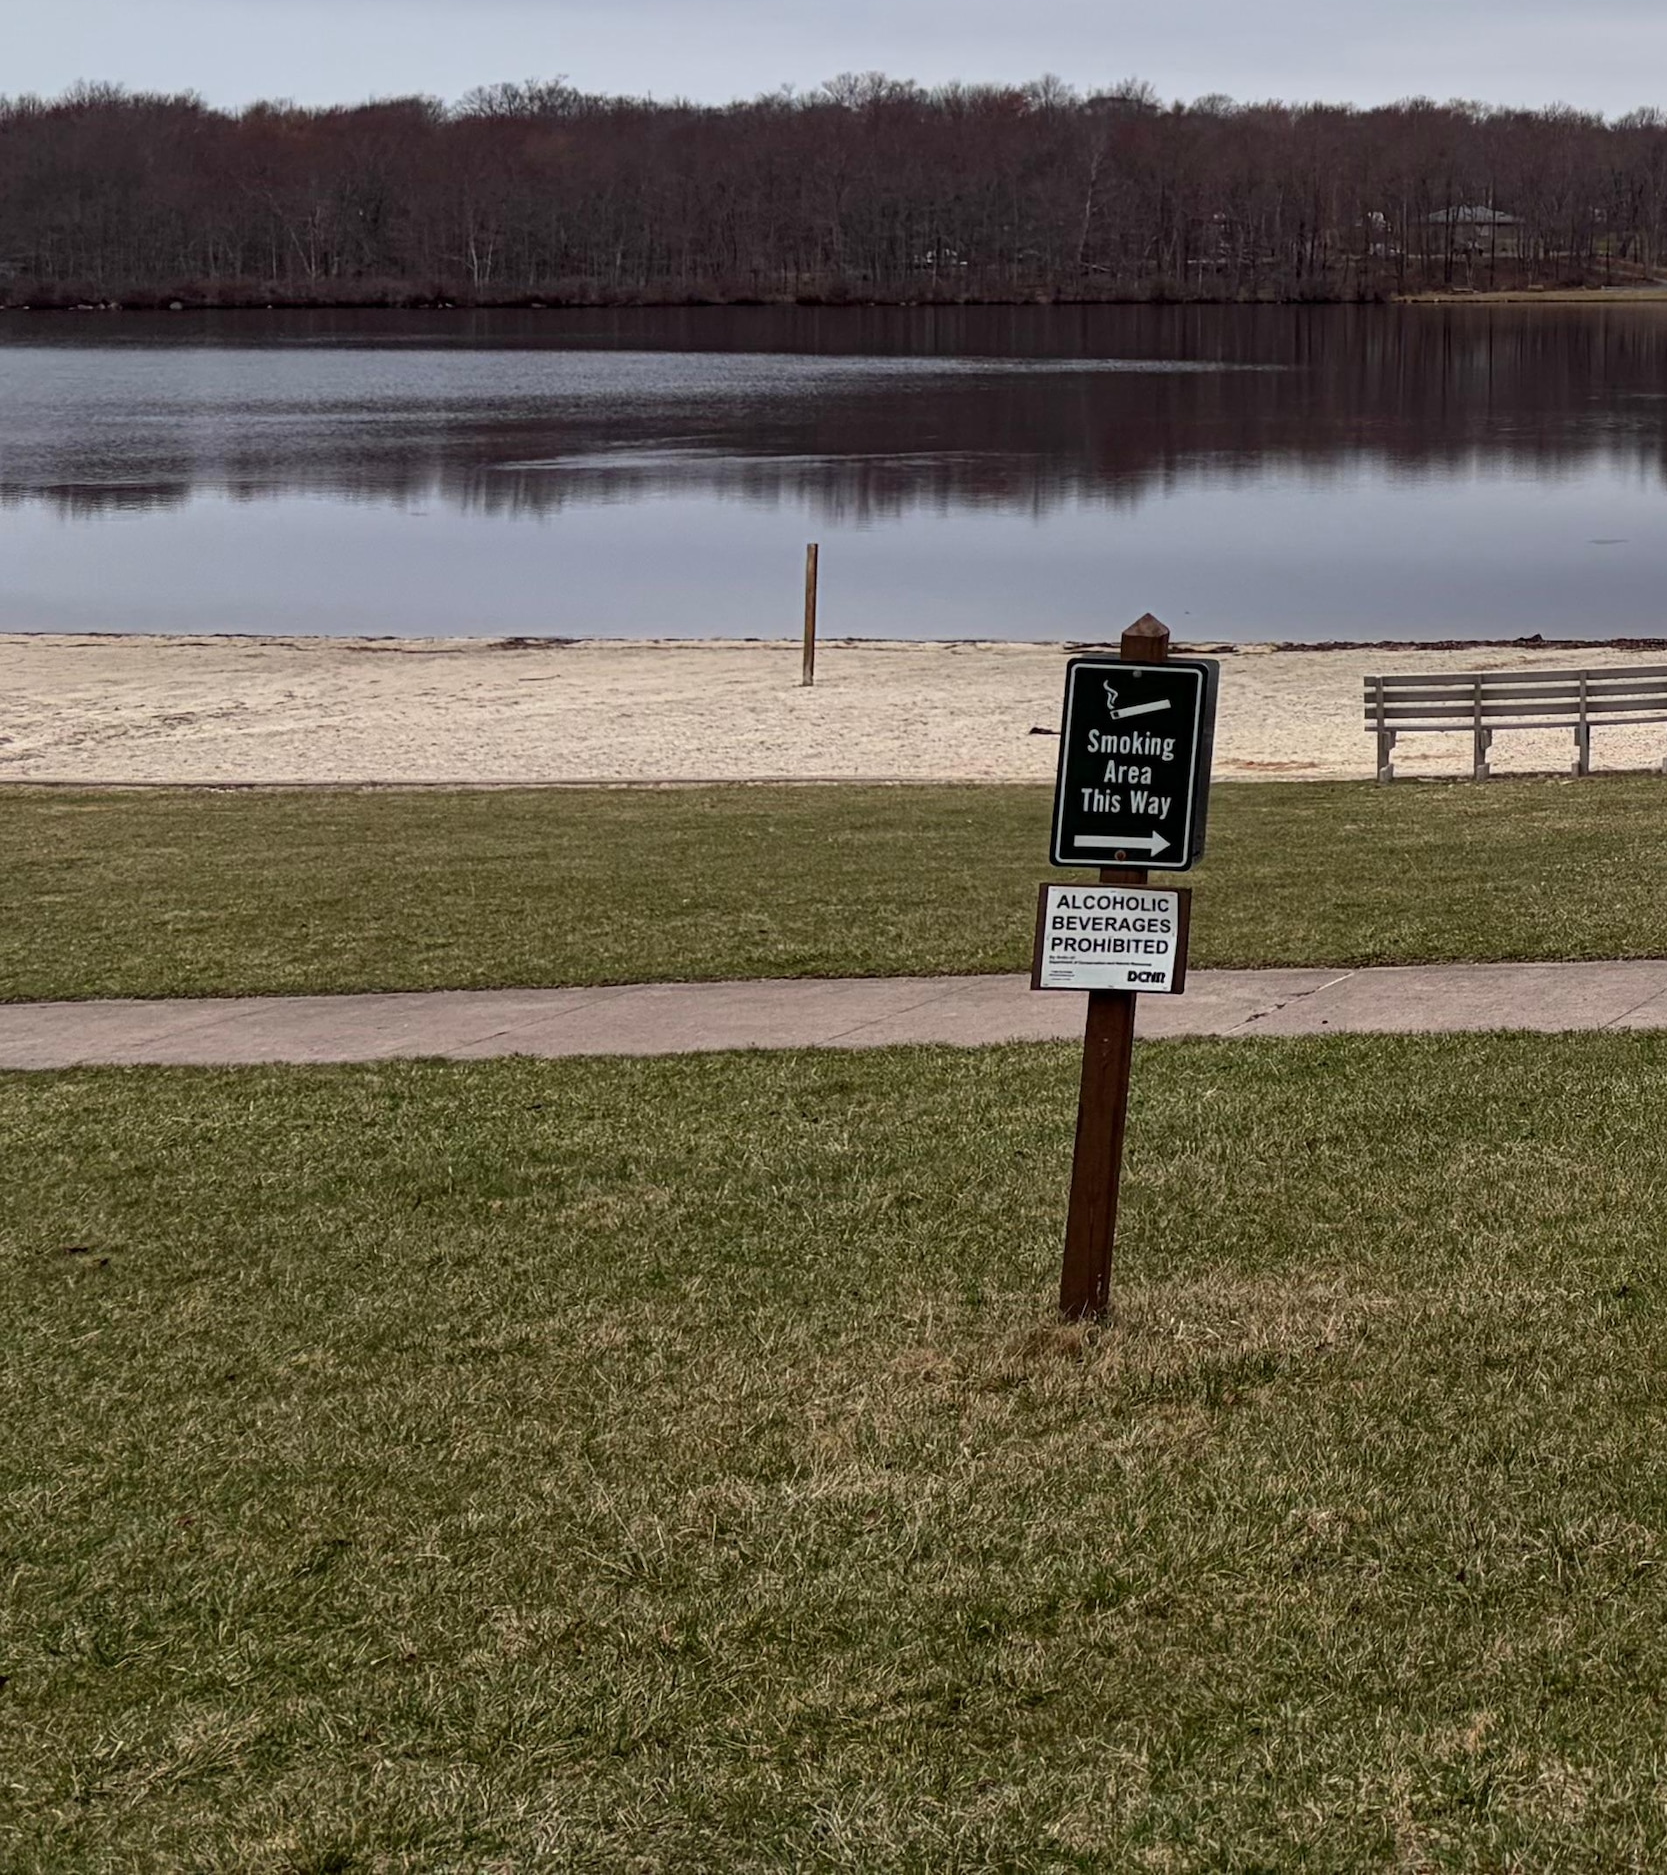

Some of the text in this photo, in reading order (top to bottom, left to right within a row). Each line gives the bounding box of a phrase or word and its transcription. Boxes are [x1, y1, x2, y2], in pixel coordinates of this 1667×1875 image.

[1087, 728, 1176, 761] Smoking
[1103, 759, 1152, 785] Area
[1081, 787, 1172, 820] This Way
[1056, 894, 1170, 913] ALCOHOLIC
[1051, 916, 1172, 934] BEVERAGES
[1050, 937, 1169, 955] PROHIBITED
